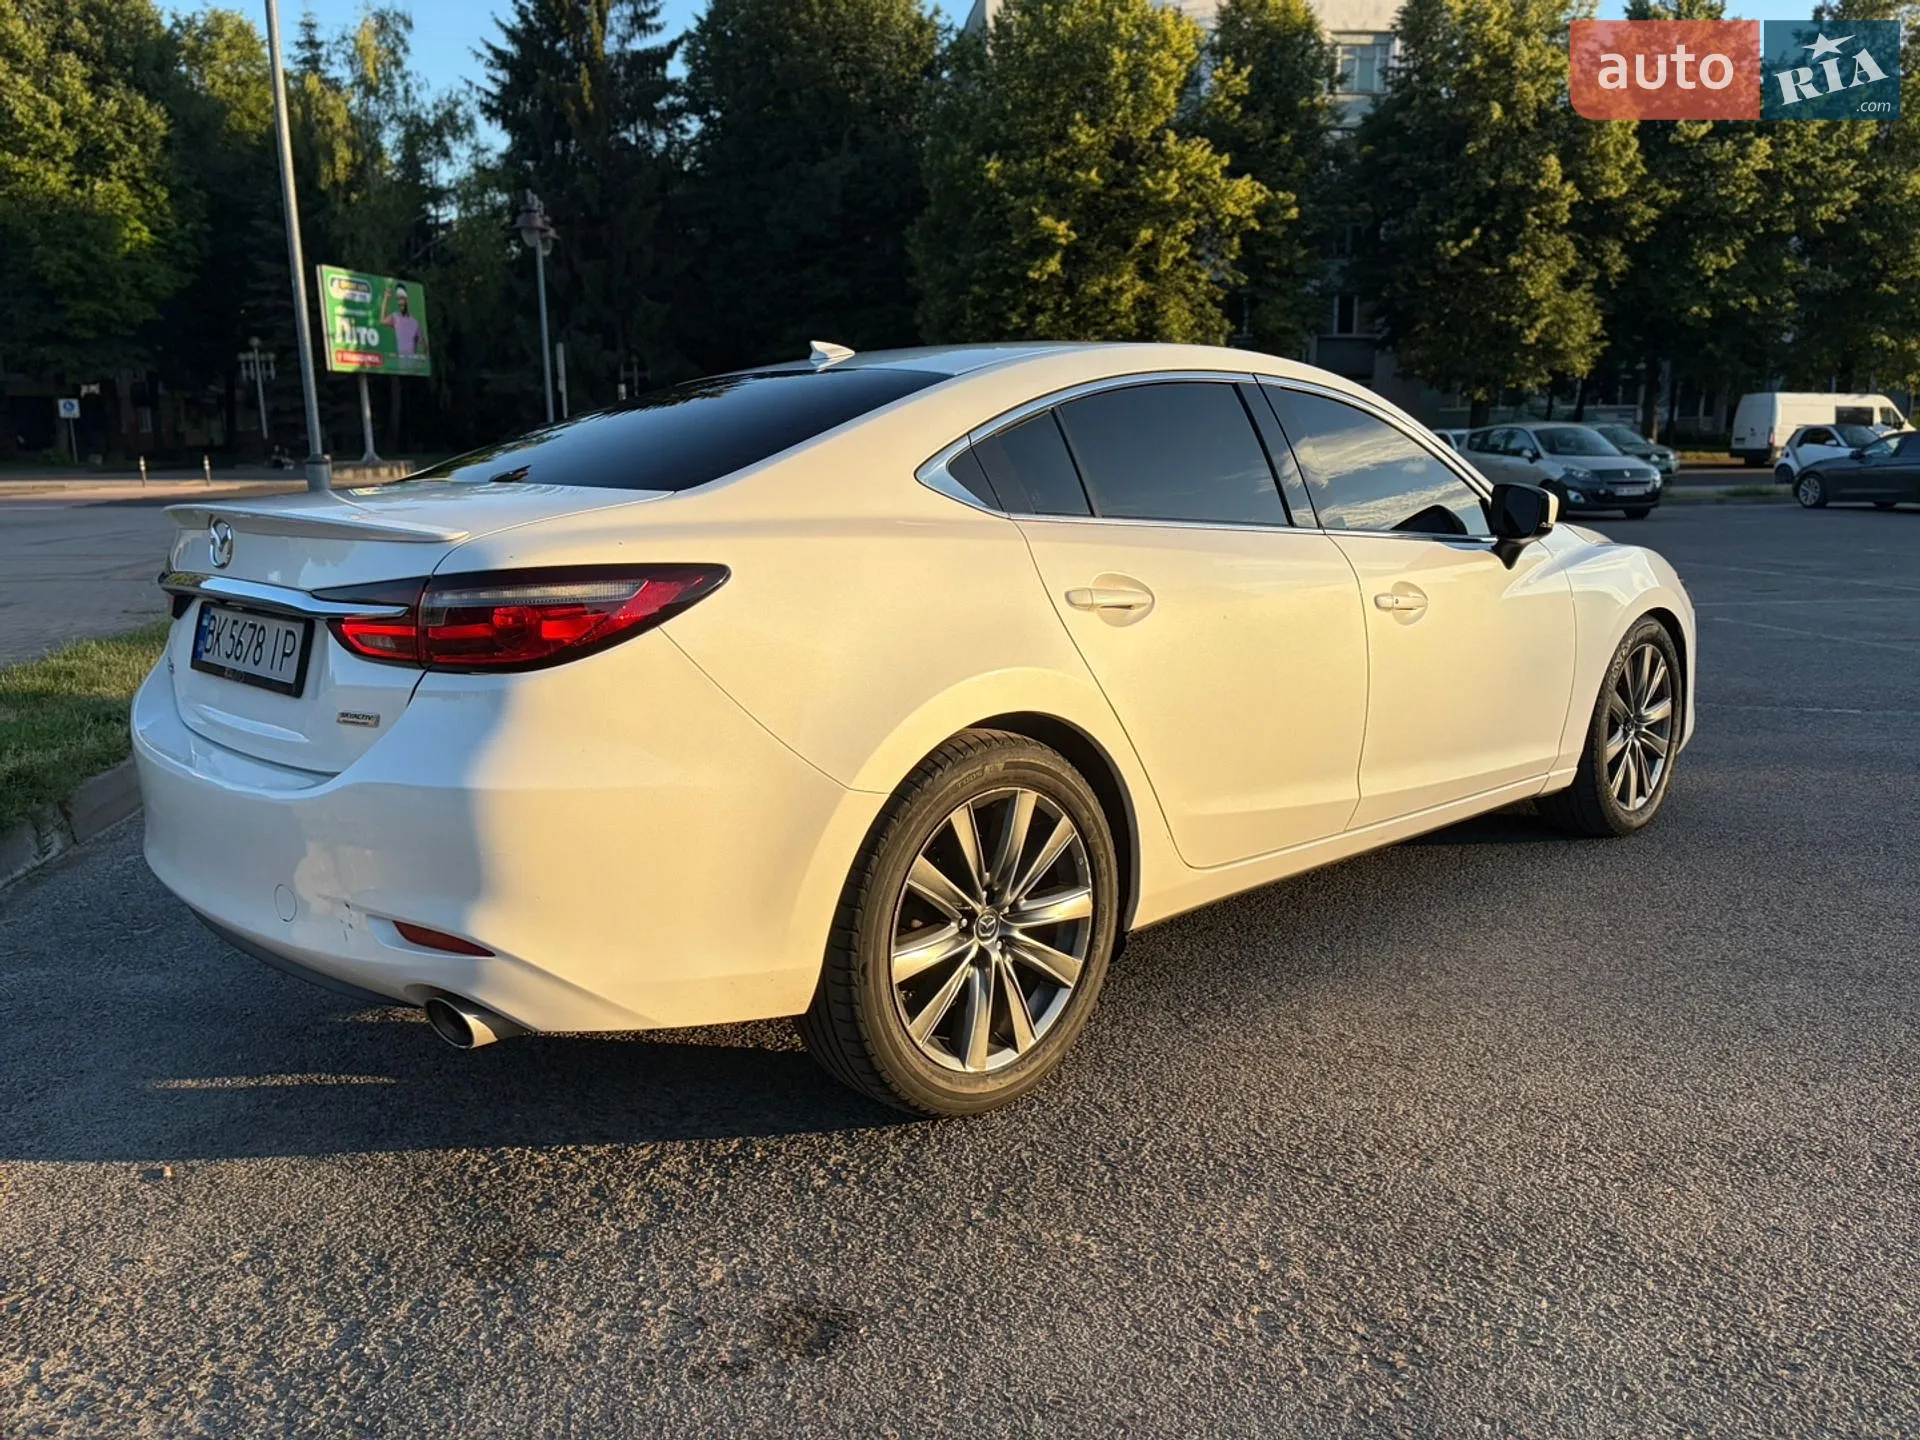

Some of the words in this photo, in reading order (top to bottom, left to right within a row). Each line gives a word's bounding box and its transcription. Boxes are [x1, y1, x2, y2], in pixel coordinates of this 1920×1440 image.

[204, 615, 228, 657] BK
[225, 620, 266, 666] 5678
[270, 627, 296, 672] IP
